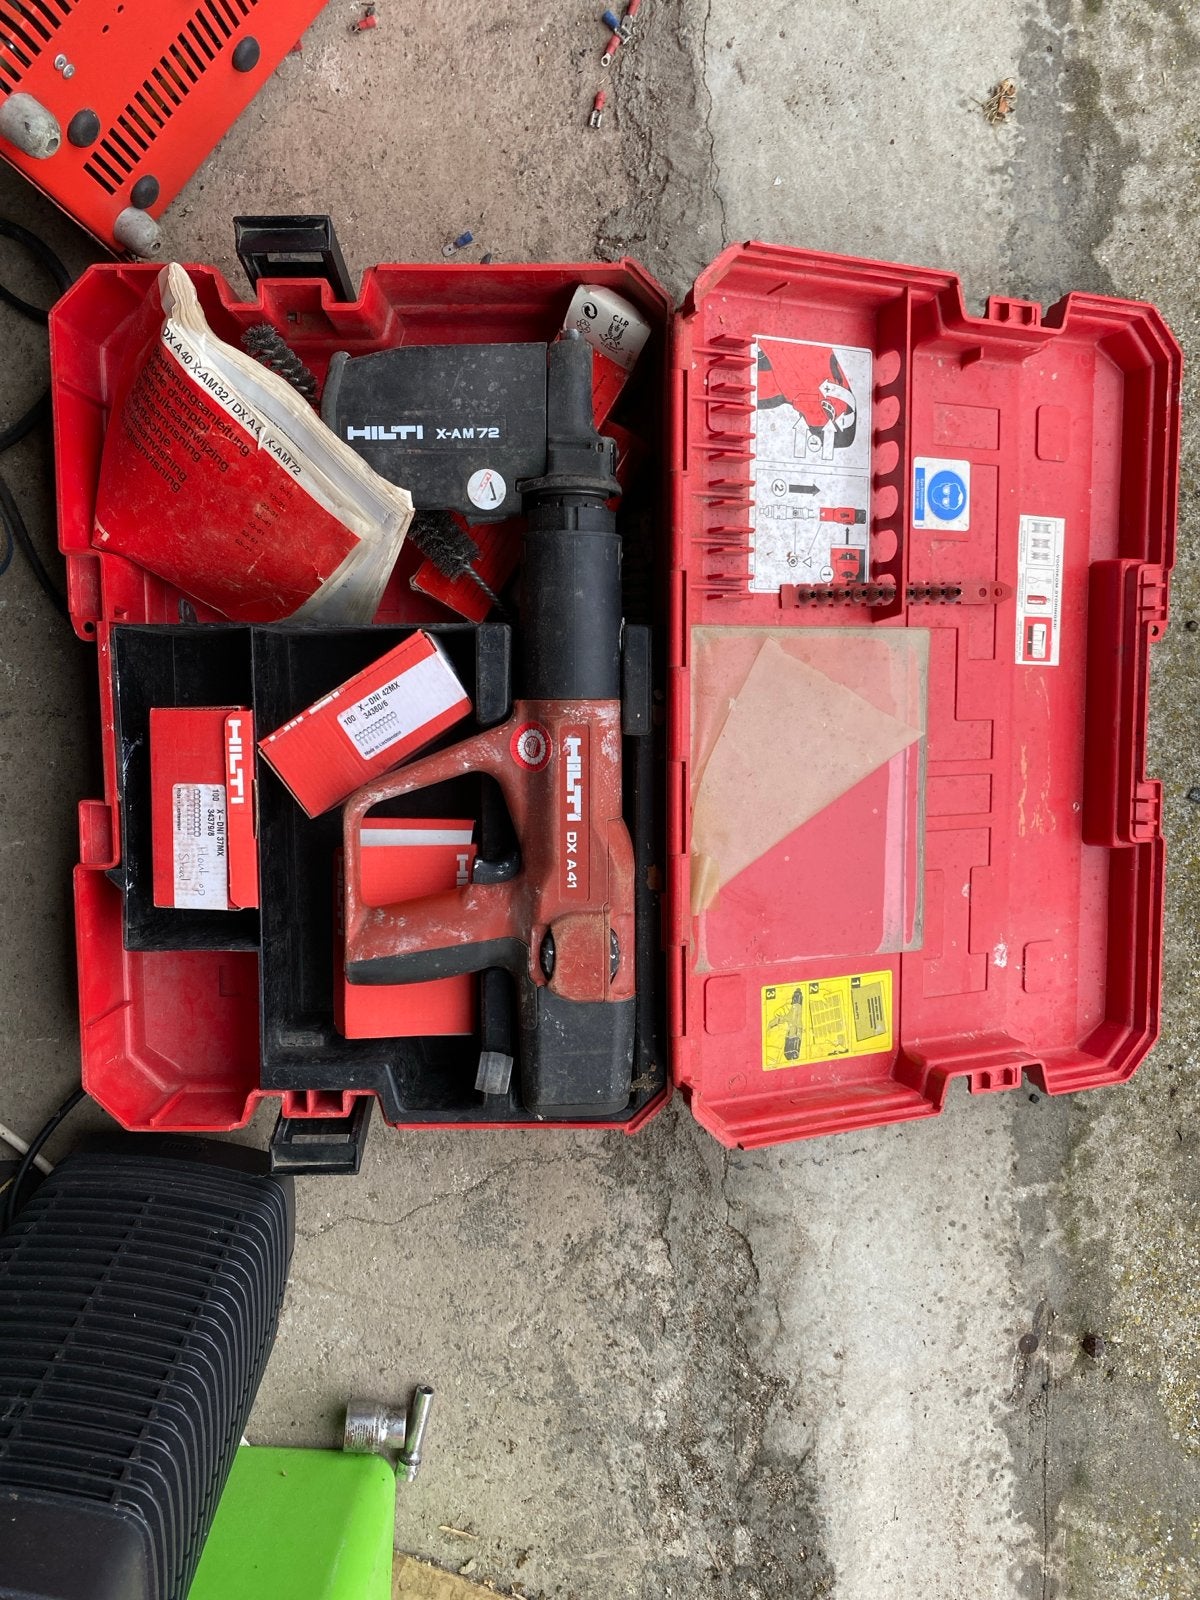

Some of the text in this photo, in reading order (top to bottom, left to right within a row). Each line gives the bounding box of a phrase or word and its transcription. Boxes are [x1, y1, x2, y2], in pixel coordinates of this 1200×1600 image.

[190, 362, 229, 401] X-AM32
[232, 402, 248, 421] DX
[246, 419, 262, 436] A4
[266, 438, 302, 476] X-AM72
[347, 425, 424, 440] HILTI
[344, 714, 356, 726] 100
[362, 700, 389, 720] 34380/6
[228, 720, 244, 804] HILTI
[566, 736, 582, 822] HILTI
[212, 788, 220, 802] 100
[566, 832, 577, 854] DX
[192, 884, 206, 896] op
